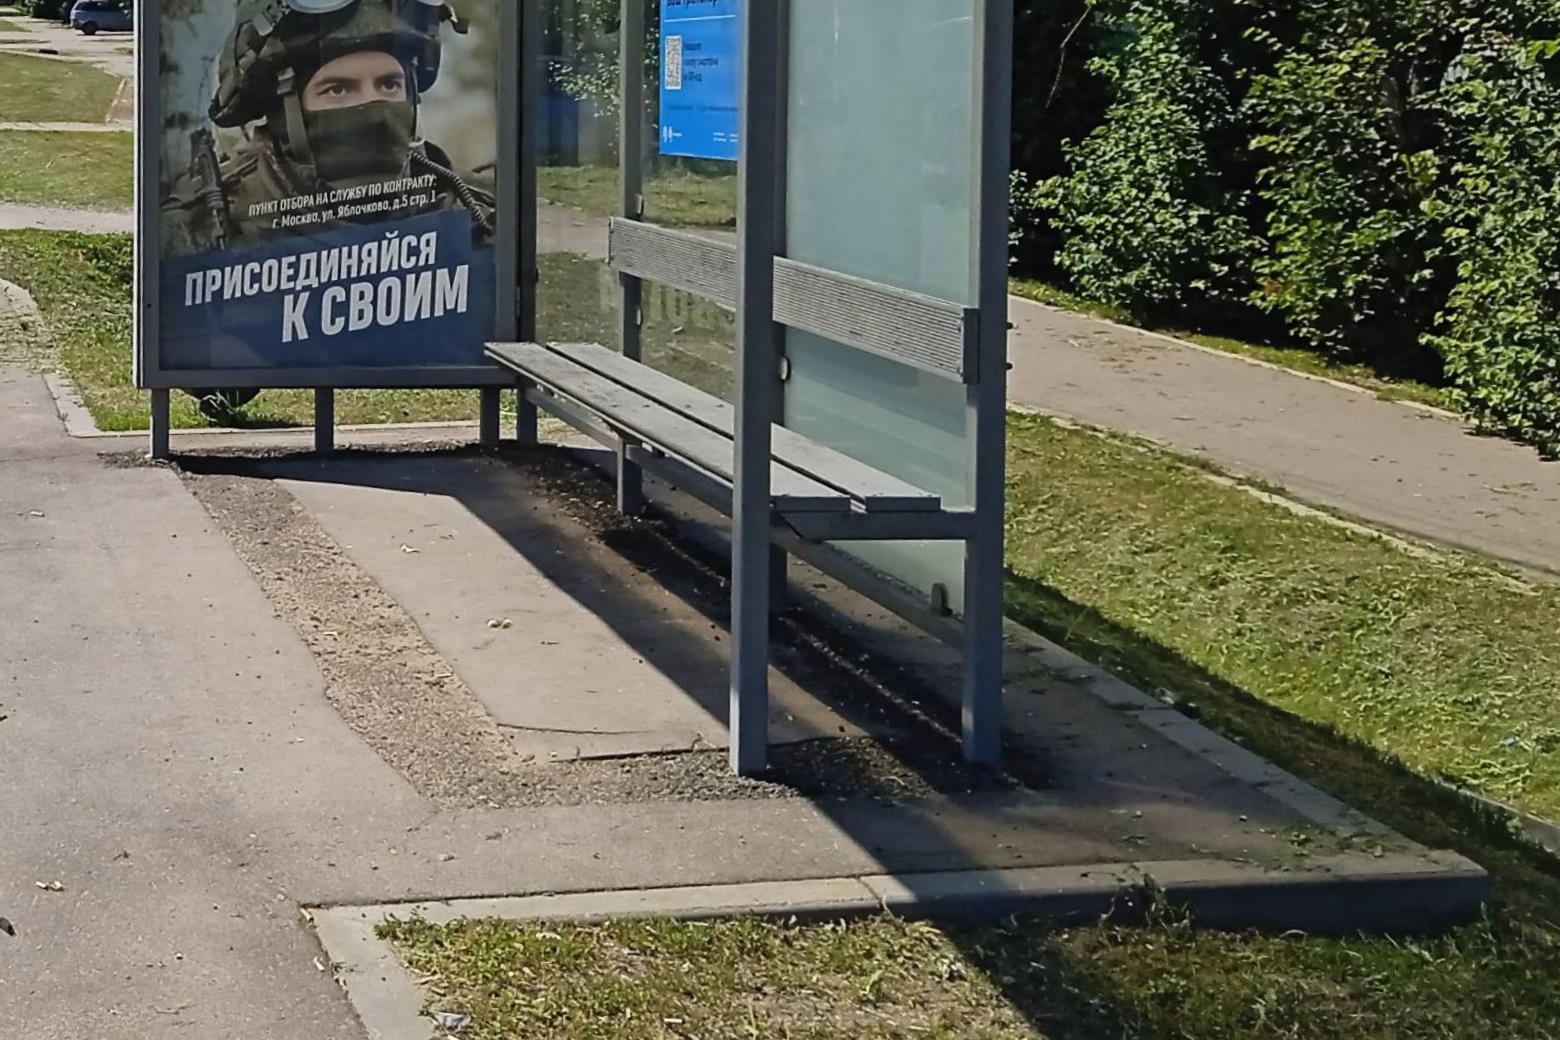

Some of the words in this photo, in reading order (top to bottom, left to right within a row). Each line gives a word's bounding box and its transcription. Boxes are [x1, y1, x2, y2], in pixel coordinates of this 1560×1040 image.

[248, 203, 278, 217] ПУНКТ
[280, 193, 315, 211] ОТБОРА
[316, 192, 329, 206] НА
[330, 186, 368, 203] СЛУЖБУ
[368, 183, 382, 197] ПО
[383, 174, 437, 194] КОНТРАКТУ:
[272, 219, 280, 229] г.
[281, 212, 321, 229] Москва,
[322, 209, 336, 224] ул.
[409, 195, 428, 209] стр.
[430, 190, 436, 203] 1
[184, 230, 437, 307] ПРИСОЕДИНЯЙСЯ
[281, 293, 313, 344] К
[321, 264, 470, 335] СВОИМ
